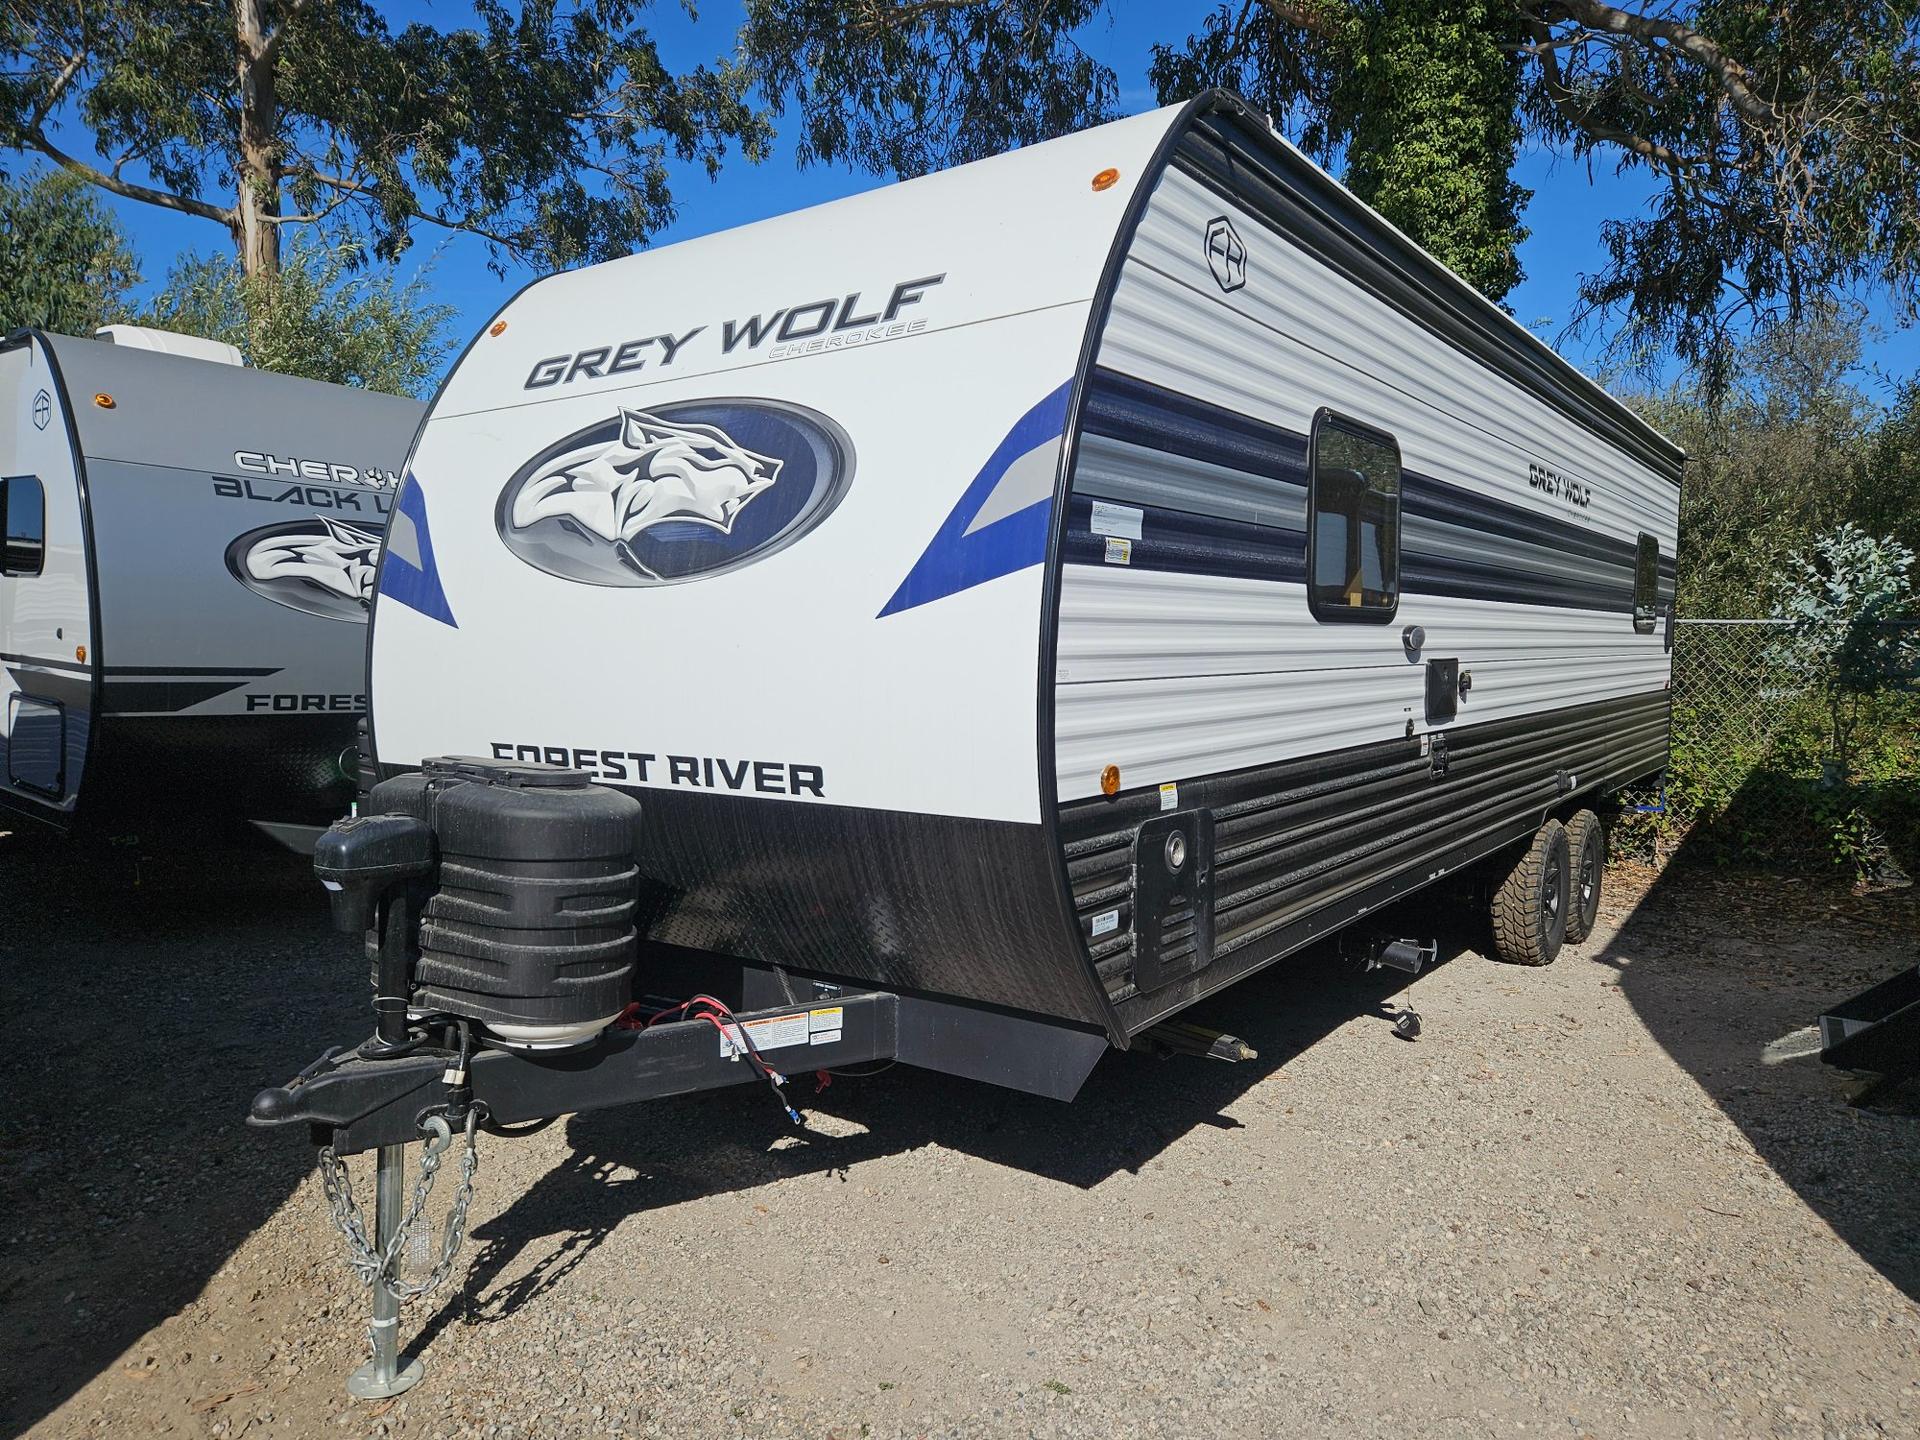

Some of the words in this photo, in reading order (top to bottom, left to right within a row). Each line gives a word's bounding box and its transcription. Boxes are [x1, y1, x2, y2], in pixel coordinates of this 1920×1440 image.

[523, 324, 708, 390] GREY
[722, 272, 947, 354] WOLF
[768, 319, 928, 359] CHEROKEE
[212, 476, 361, 511] BLACK
[1529, 463, 1561, 497] GREY
[1563, 478, 1591, 508] WOLF
[490, 742, 656, 782] FOREST
[665, 754, 825, 798] RIVER
